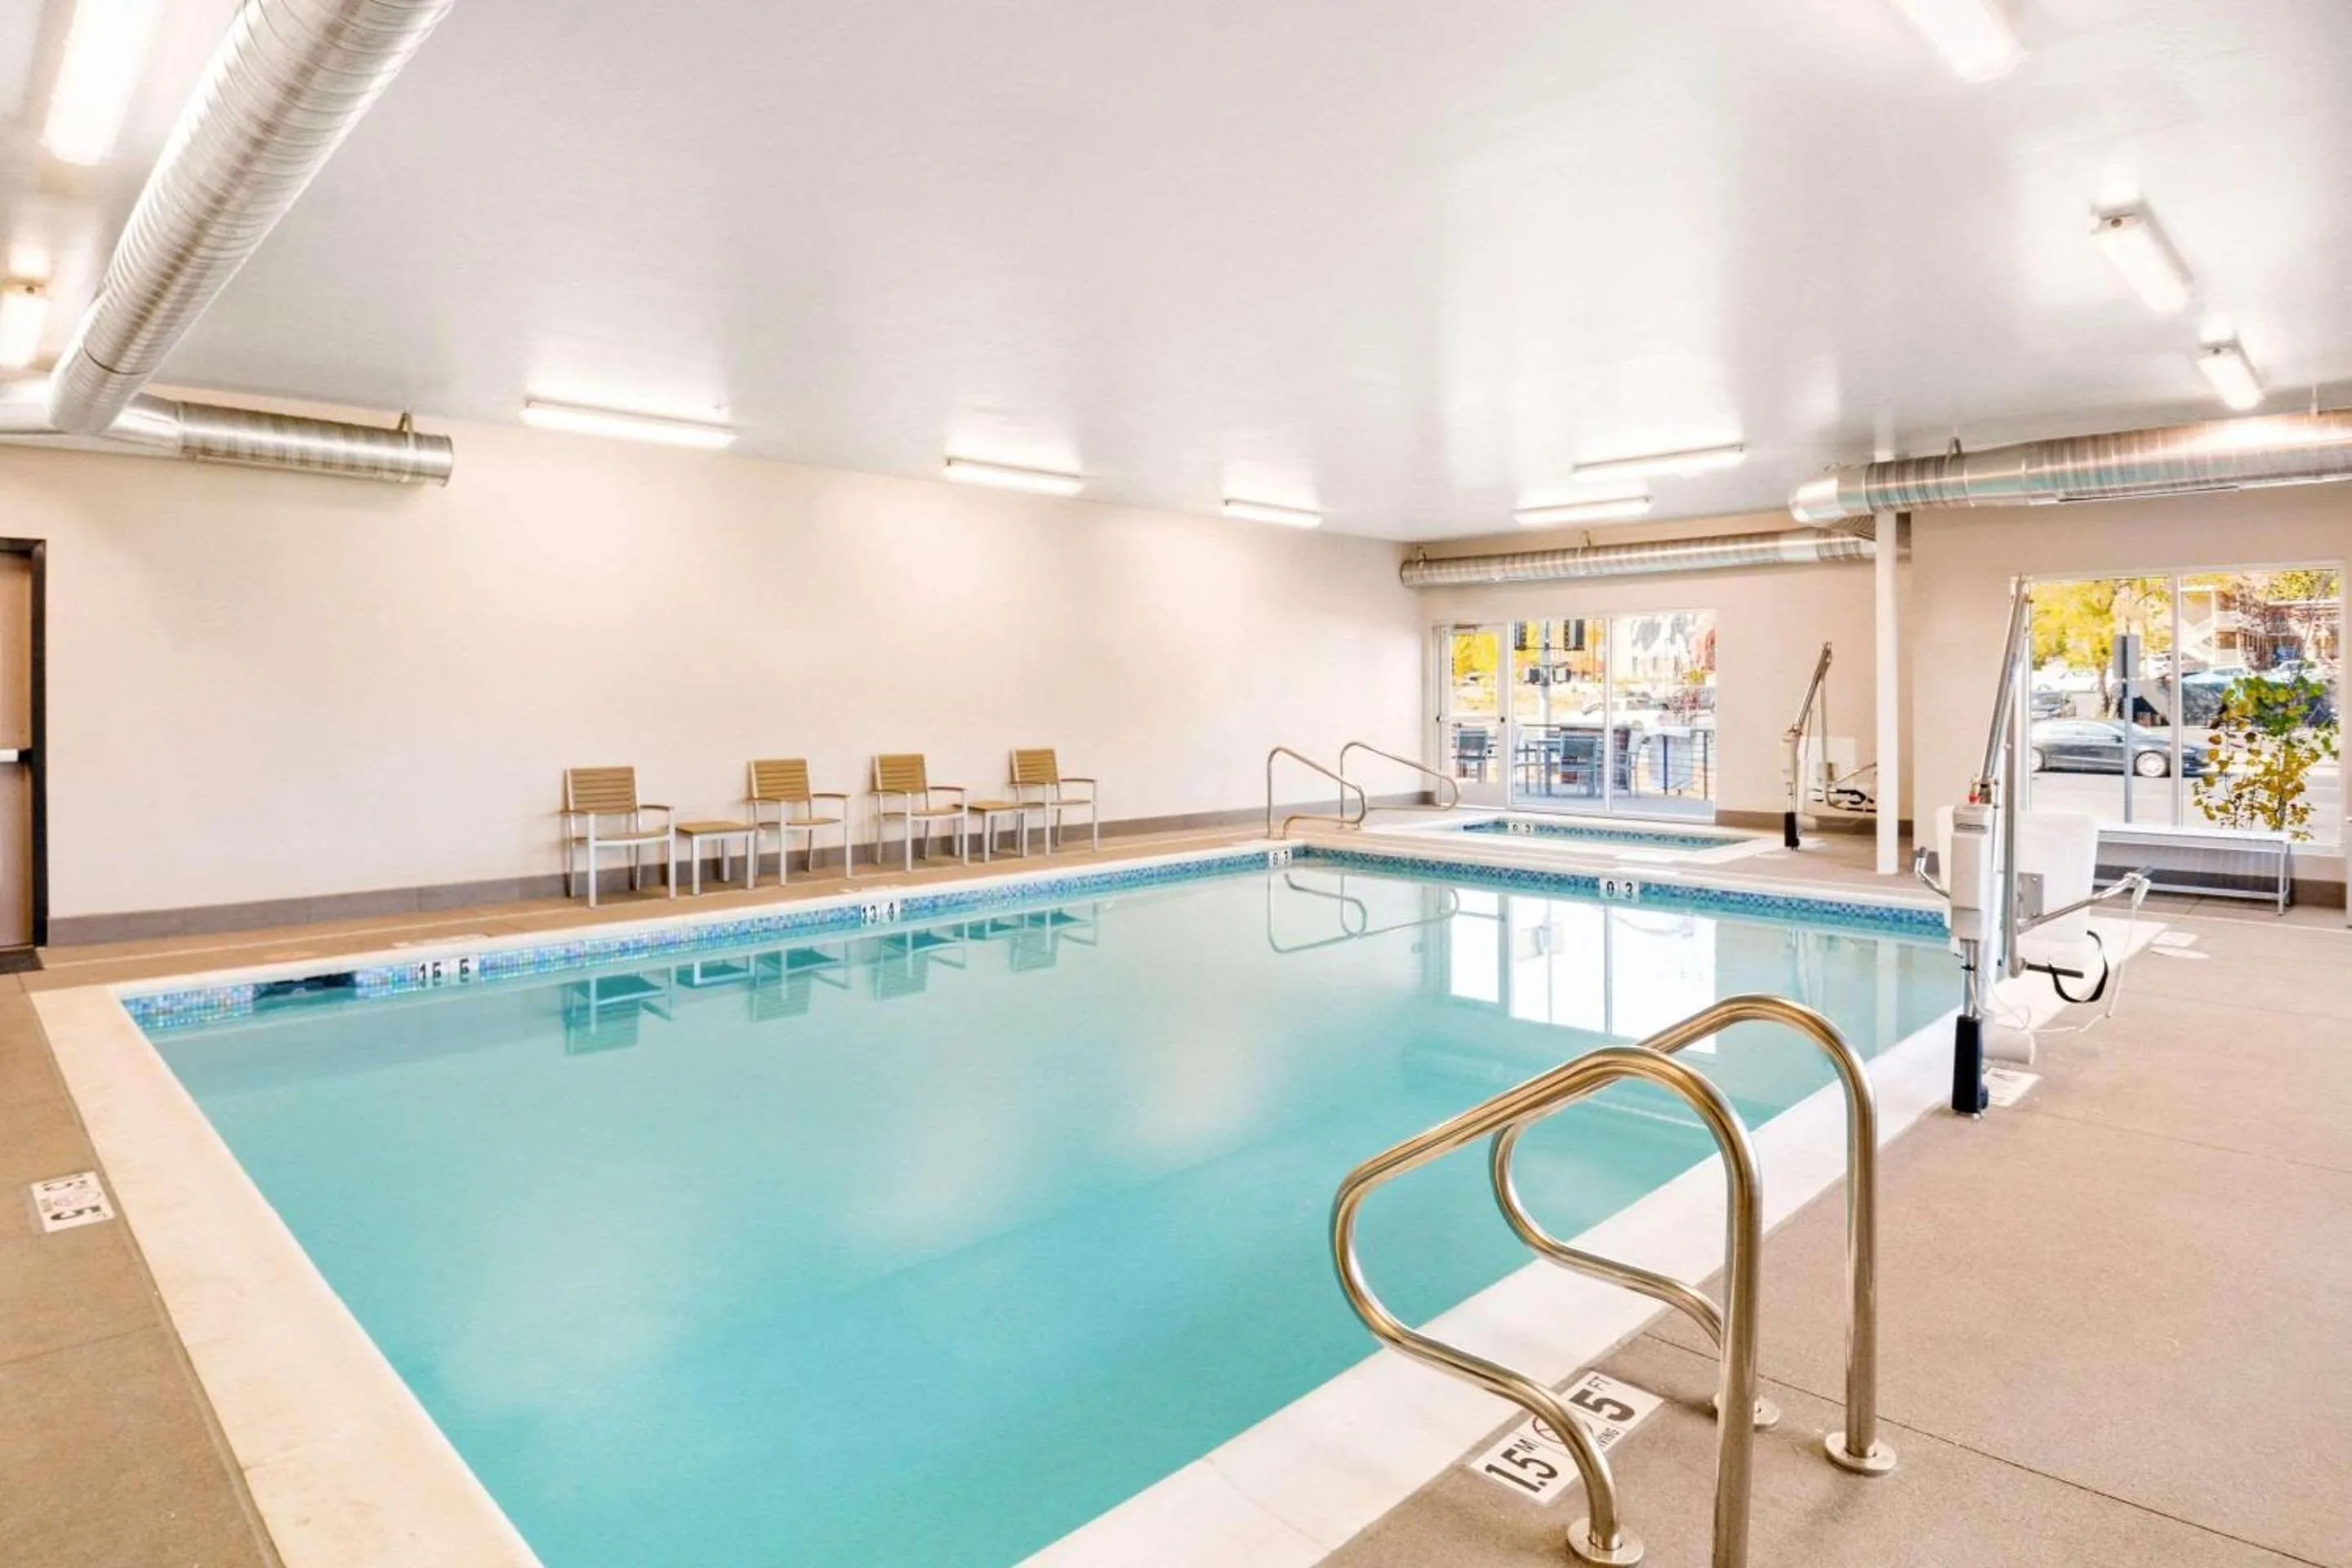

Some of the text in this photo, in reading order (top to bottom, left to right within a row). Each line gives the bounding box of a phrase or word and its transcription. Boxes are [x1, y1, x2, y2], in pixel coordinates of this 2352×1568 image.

[1568, 1375, 1636, 1422] 5 FT
[1485, 1438, 1558, 1494] 1.5 M
